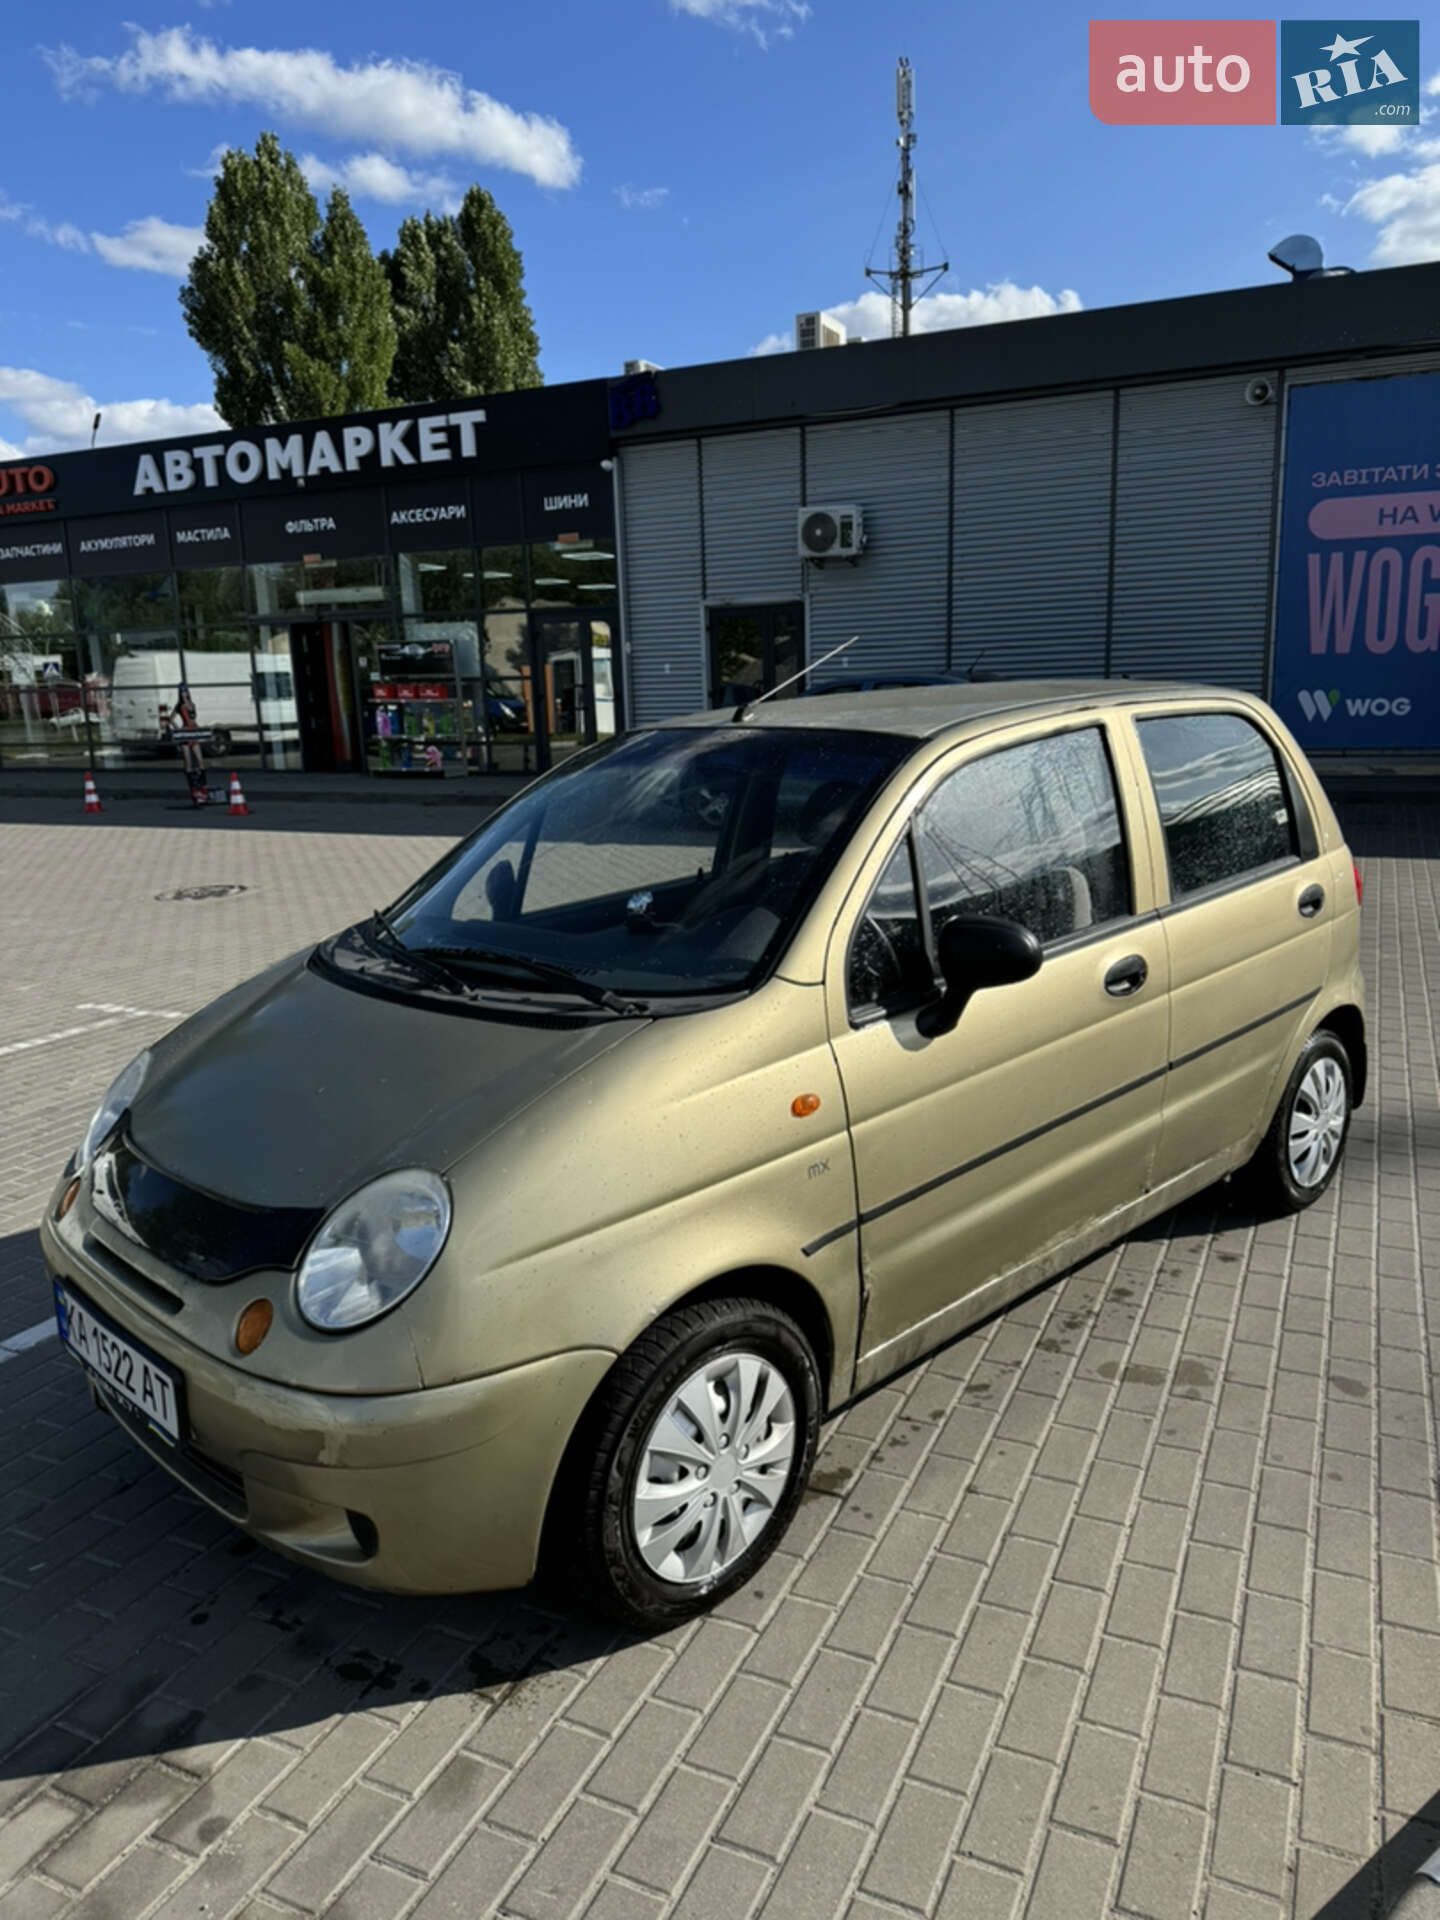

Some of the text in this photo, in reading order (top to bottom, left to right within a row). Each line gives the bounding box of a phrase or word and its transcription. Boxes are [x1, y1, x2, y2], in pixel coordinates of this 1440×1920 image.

[133, 409, 487, 496] АВТОМАРКЕТ
[1311, 463, 1429, 488] ЗАВІТАТИ
[544, 493, 589, 511] ШИНИ
[390, 505, 466, 525] АКСЕСУАРИ
[1378, 505, 1419, 526] НА
[176, 527, 231, 544] МАСТИЛА
[285, 517, 336, 534] ФІЛЬТРА
[80, 533, 155, 553] АКУМУЛЯТОРИ
[1308, 545, 1440, 655] WOG
[1345, 697, 1411, 717] WOG
[66, 1305, 91, 1355] KA
[92, 1327, 137, 1396] 1522
[143, 1364, 170, 1421] AT
